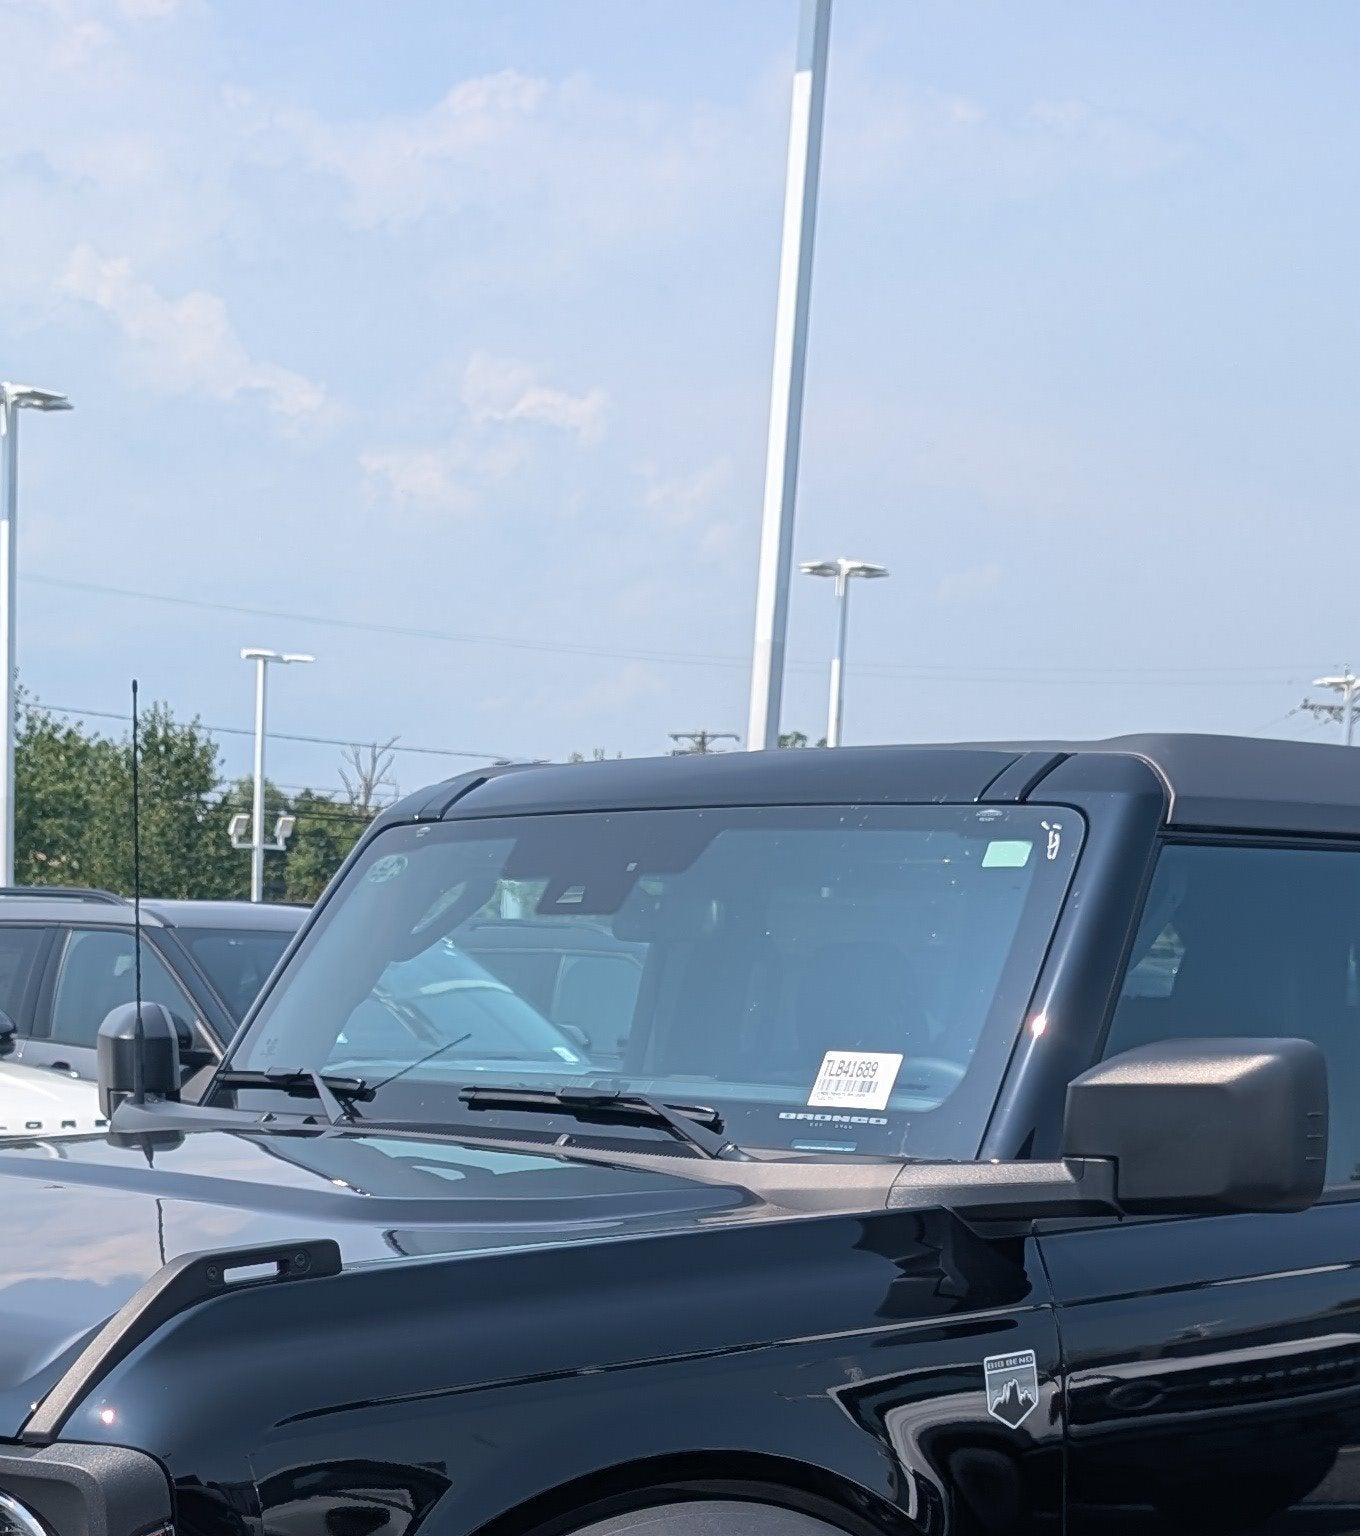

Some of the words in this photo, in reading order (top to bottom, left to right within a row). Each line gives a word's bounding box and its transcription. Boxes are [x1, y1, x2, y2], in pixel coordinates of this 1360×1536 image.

[824, 1059, 879, 1079] TLB41689
[778, 1112, 888, 1125] BRONCO
[987, 1361, 1005, 1370] BIG
[1005, 1355, 1033, 1367] BEND
